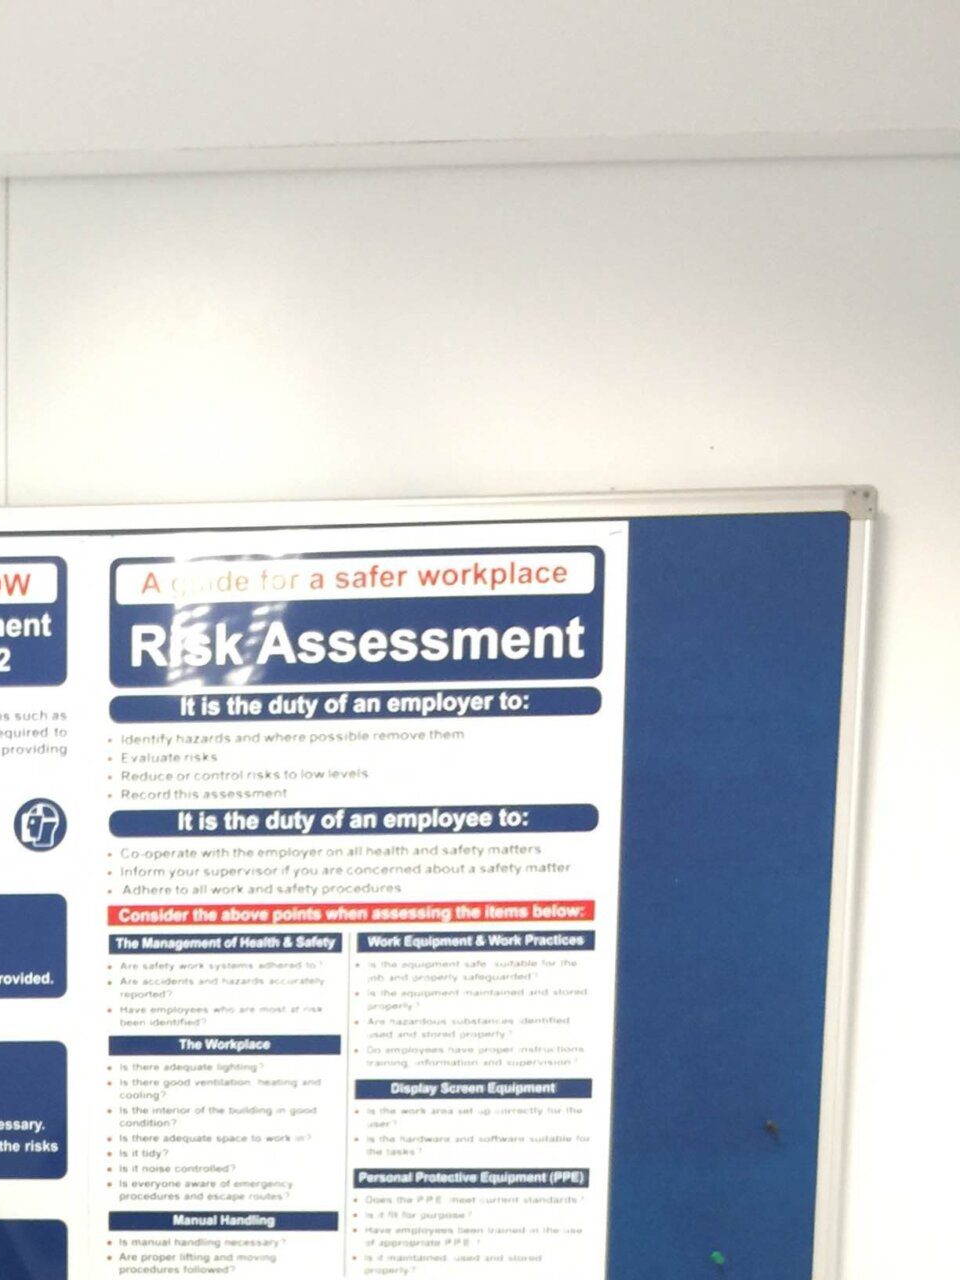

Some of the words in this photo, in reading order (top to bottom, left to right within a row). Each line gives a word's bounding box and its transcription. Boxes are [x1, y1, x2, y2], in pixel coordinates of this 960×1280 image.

[141, 572, 160, 593] A
[171, 572, 249, 596] gide
[261, 570, 298, 589] for
[309, 573, 324, 589] a
[335, 564, 407, 588] safer
[417, 560, 567, 590] workplace
[131, 622, 243, 667] Risk
[256, 616, 585, 665] Assessment
[180, 697, 195, 716] It
[201, 697, 220, 716] is
[228, 695, 257, 715] the
[263, 695, 316, 719] duty
[324, 694, 348, 713] of
[353, 698, 377, 712] an
[386, 692, 493, 715] employer
[500, 693, 530, 710] to:
[14, 710, 47, 720] such
[51, 712, 67, 720] as
[121, 752, 180, 762] Evaluate
[184, 752, 217, 761] risks
[120, 789, 171, 799] Record
[173, 789, 199, 799] this
[202, 788, 287, 798] assessment
[178, 811, 192, 830] It
[198, 811, 217, 829] is
[223, 808, 257, 830] the
[263, 807, 315, 834] duty
[320, 807, 345, 828] of
[349, 811, 377, 827] an
[382, 805, 492, 833] employee
[498, 806, 529, 825] to:
[119, 908, 189, 922] Consider
[193, 909, 217, 922] the
[221, 908, 268, 921] above
[273, 908, 321, 923] points
[326, 908, 367, 920] when
[372, 907, 451, 922] assessing
[456, 906, 481, 919] the
[485, 906, 527, 918] items
[533, 905, 584, 917] below:
[116, 938, 138, 949] The
[142, 937, 221, 951] Management
[224, 936, 237, 948] of
[240, 936, 279, 948] Health
[283, 936, 292, 948] &
[296, 936, 335, 950] Safety
[368, 936, 401, 948] Work
[404, 935, 472, 949] Equipment
[475, 935, 485, 946] &
[489, 935, 521, 946] Work
[525, 934, 584, 946] Practices
[179, 1039, 201, 1051] The
[205, 1039, 270, 1054] Workplace
[390, 1082, 437, 1096] Display
[440, 1082, 484, 1094] Screen
[488, 1082, 555, 1095] Equipment
[24, 1140, 58, 1152] risks
[119, 1149, 128, 1157] Is
[358, 1172, 412, 1183] Personal
[416, 1172, 476, 1183] Protective
[480, 1172, 547, 1184] Equipment
[550, 1171, 584, 1184] (PPE)
[173, 1215, 218, 1226] Manual
[221, 1215, 275, 1228] Handling
